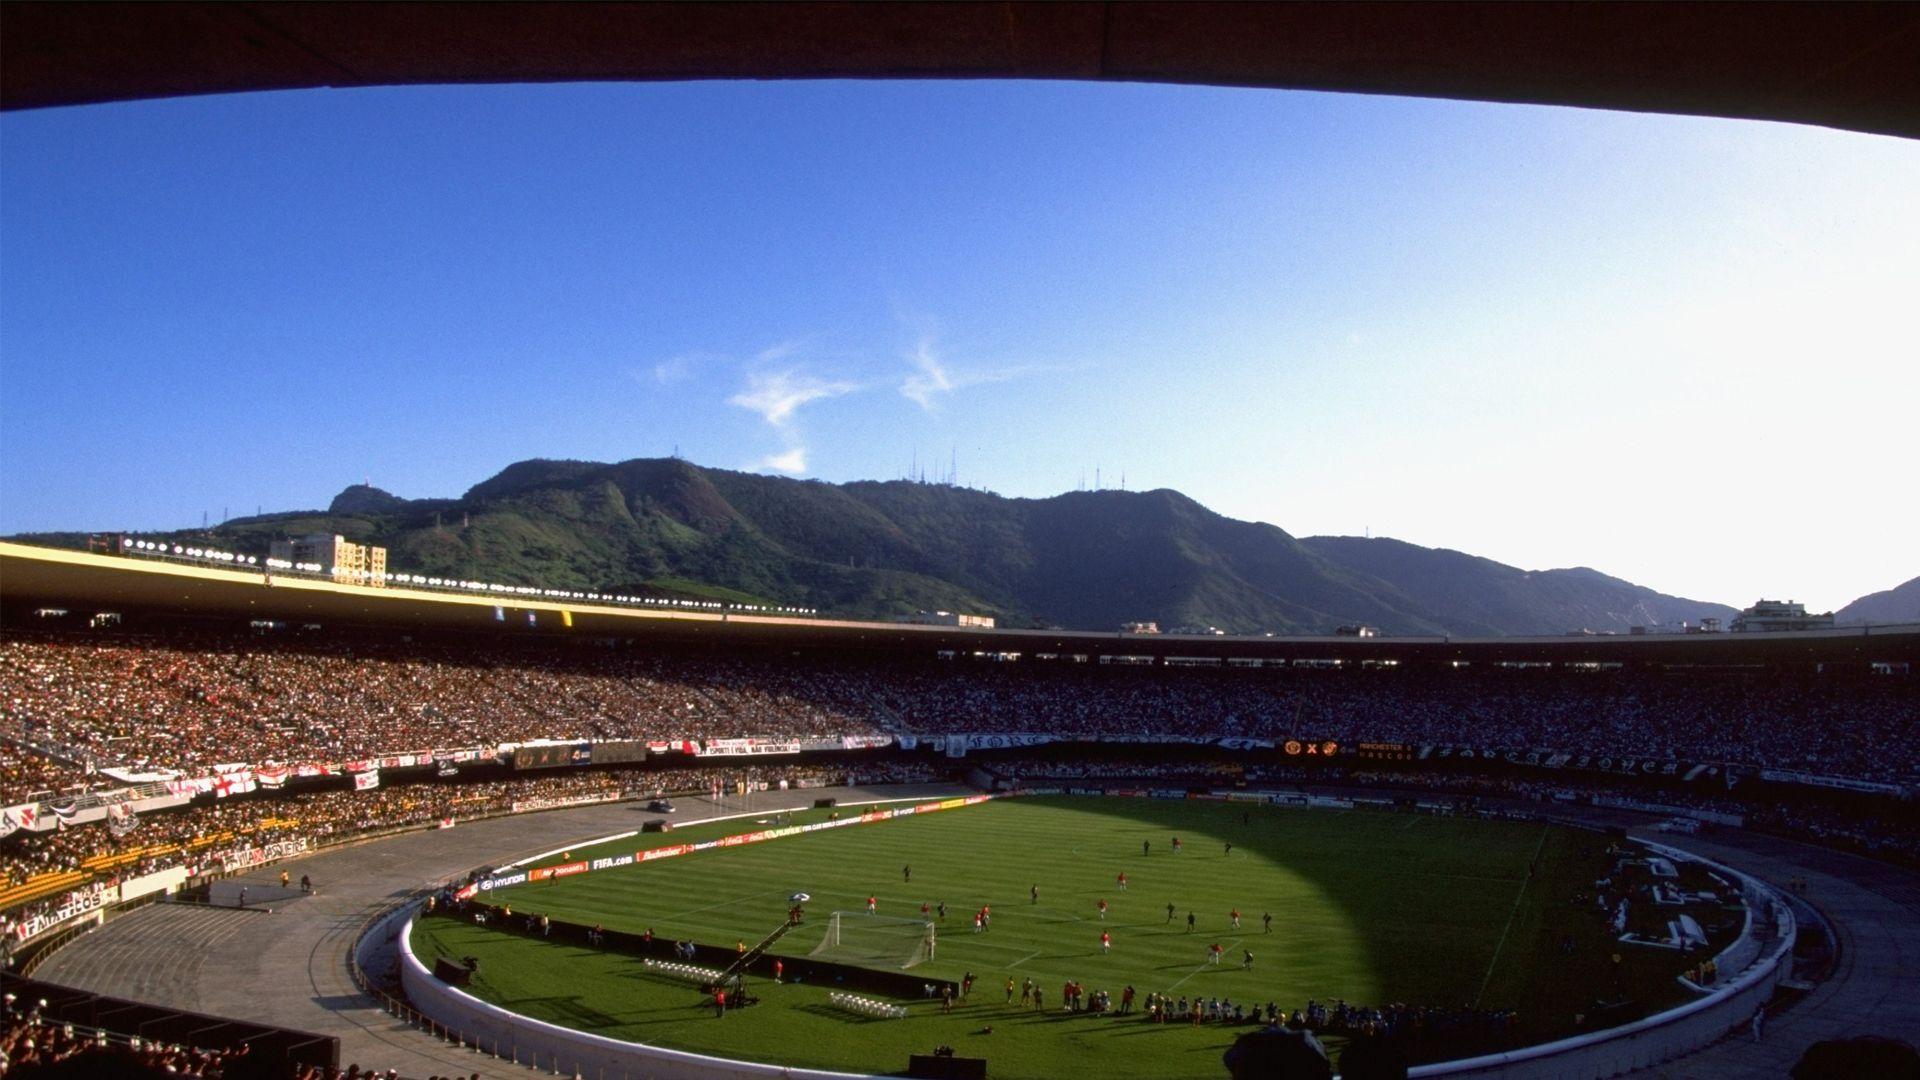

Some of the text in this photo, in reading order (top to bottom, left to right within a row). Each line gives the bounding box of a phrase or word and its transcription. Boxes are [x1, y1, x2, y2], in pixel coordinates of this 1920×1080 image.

[643, 847, 681, 861] Budweiser
[593, 855, 632, 870] FIFA.com
[495, 873, 526, 887] HYUNDAI
